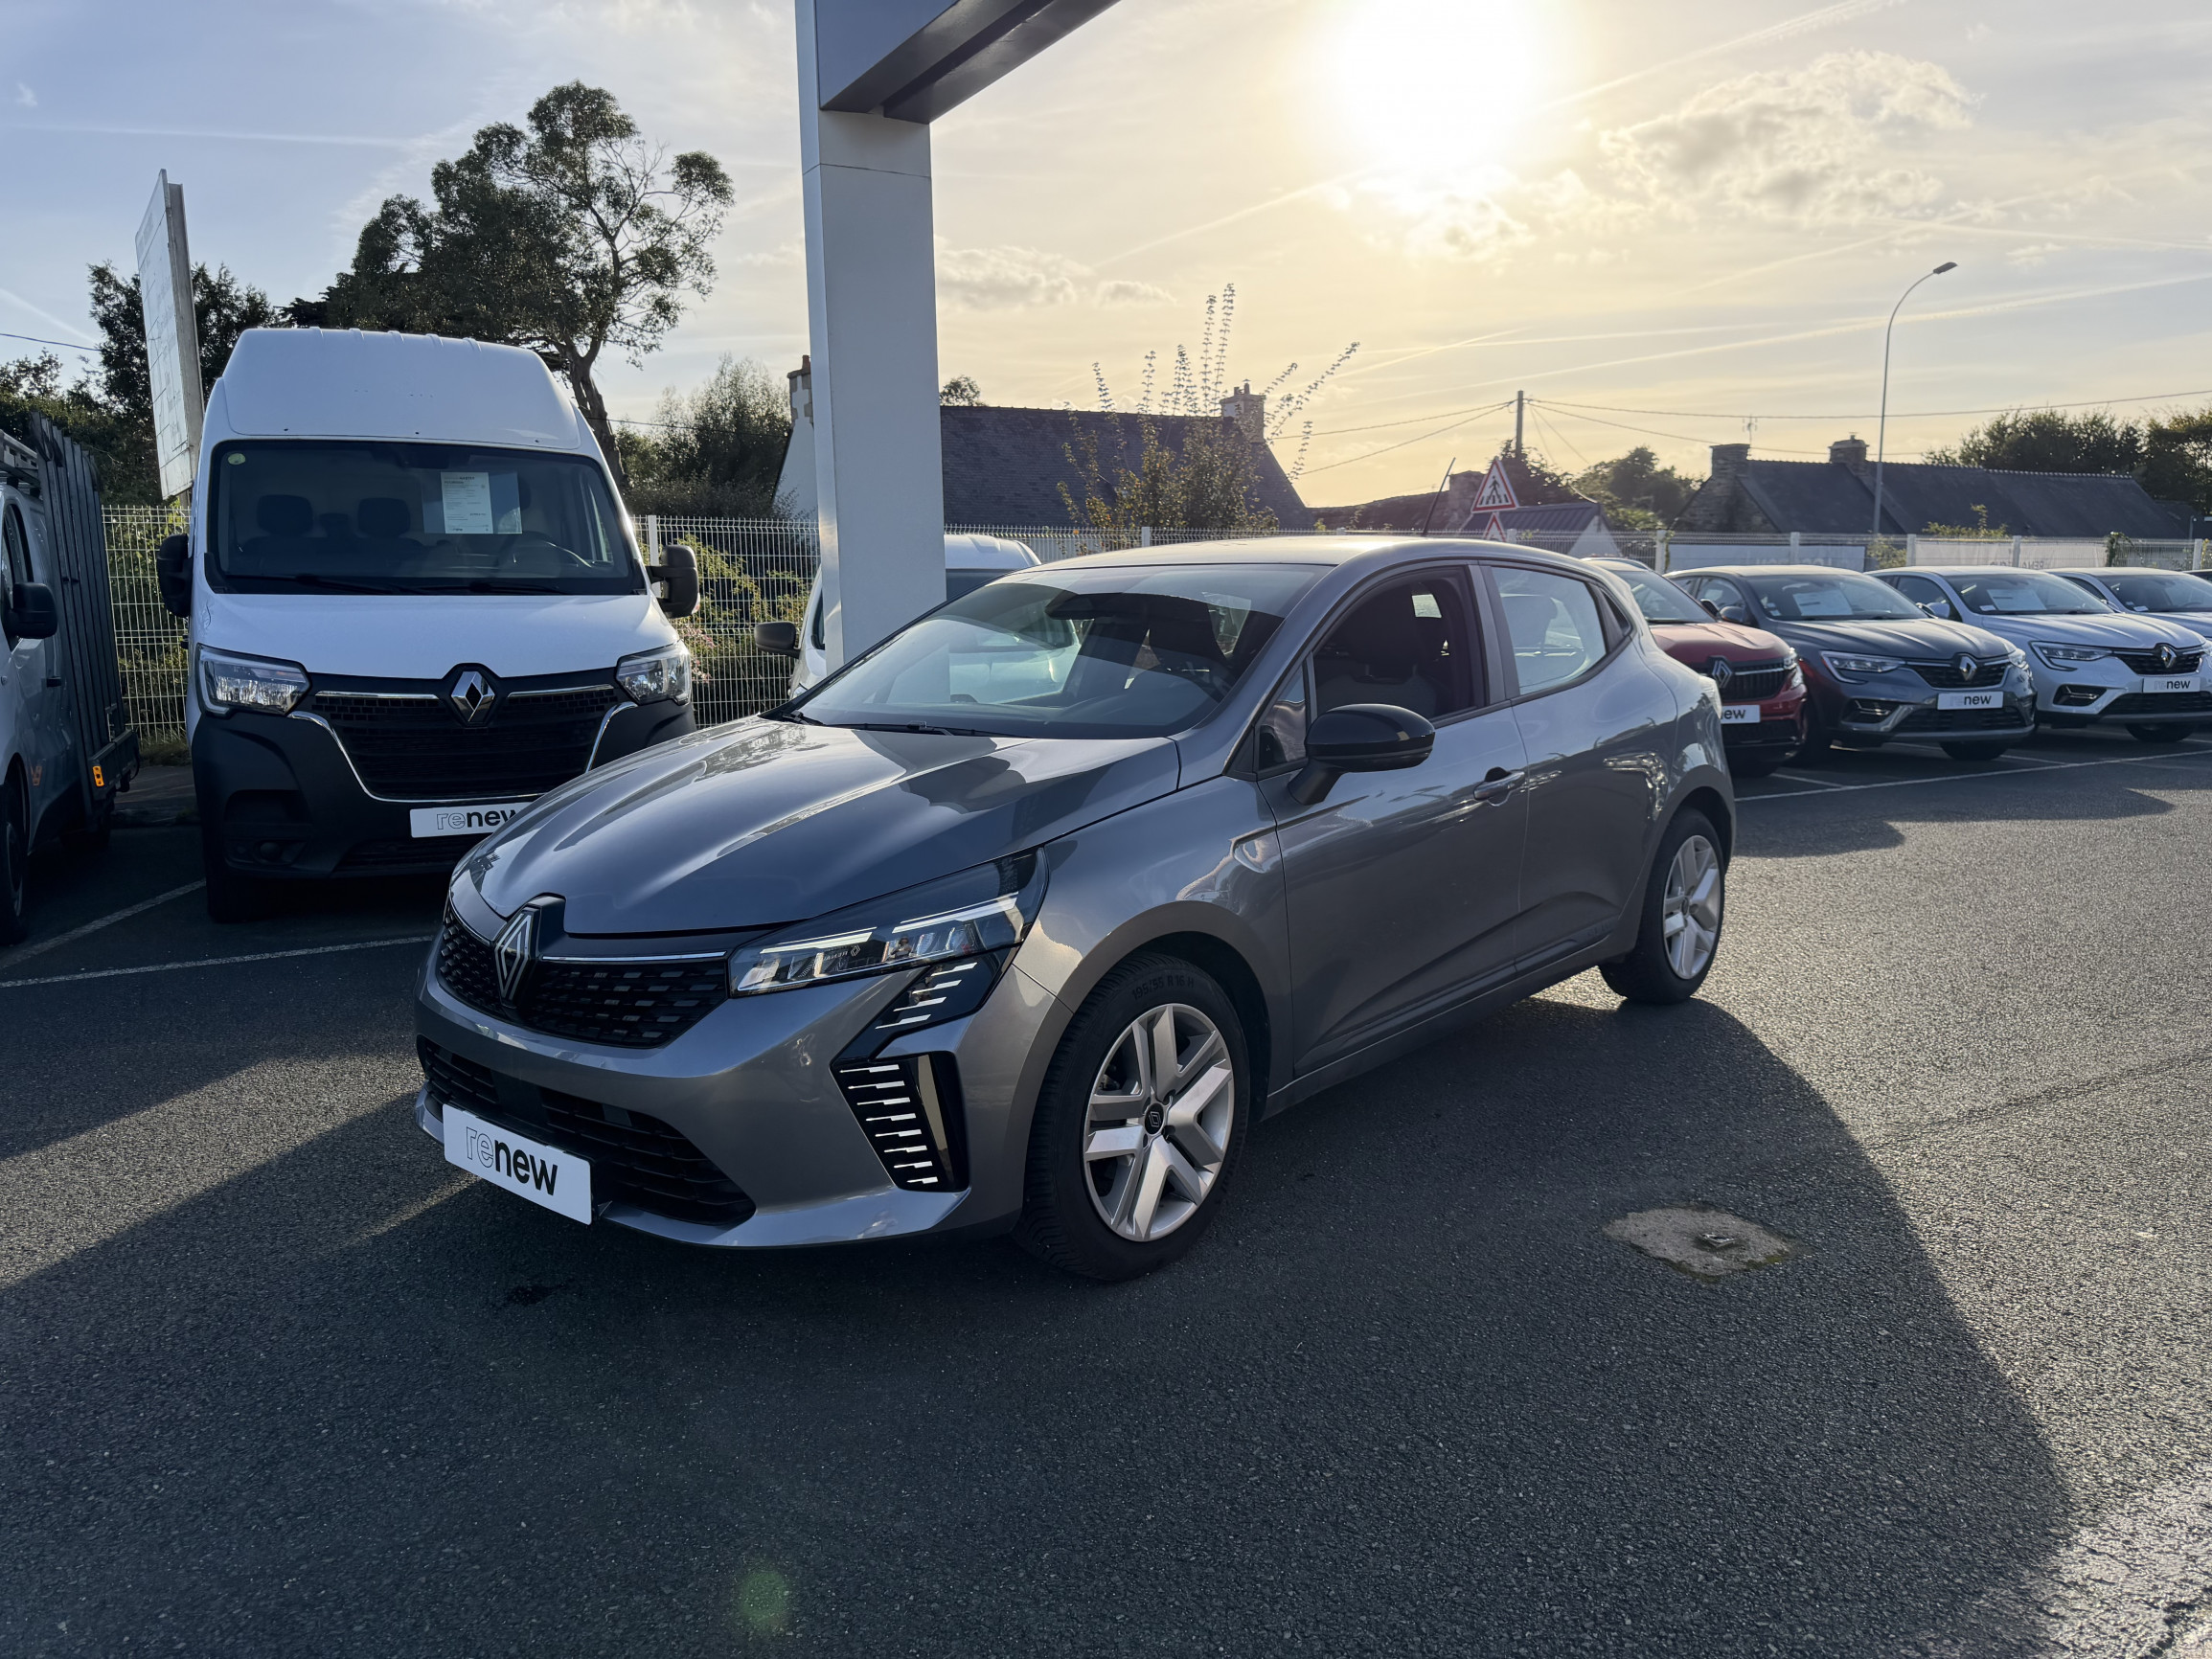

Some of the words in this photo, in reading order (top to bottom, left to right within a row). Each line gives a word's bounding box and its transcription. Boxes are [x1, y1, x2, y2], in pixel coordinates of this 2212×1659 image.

[1721, 709, 1746, 719] ew
[1131, 976, 1165, 1001] 195/55
[466, 1126, 559, 1196] renew
